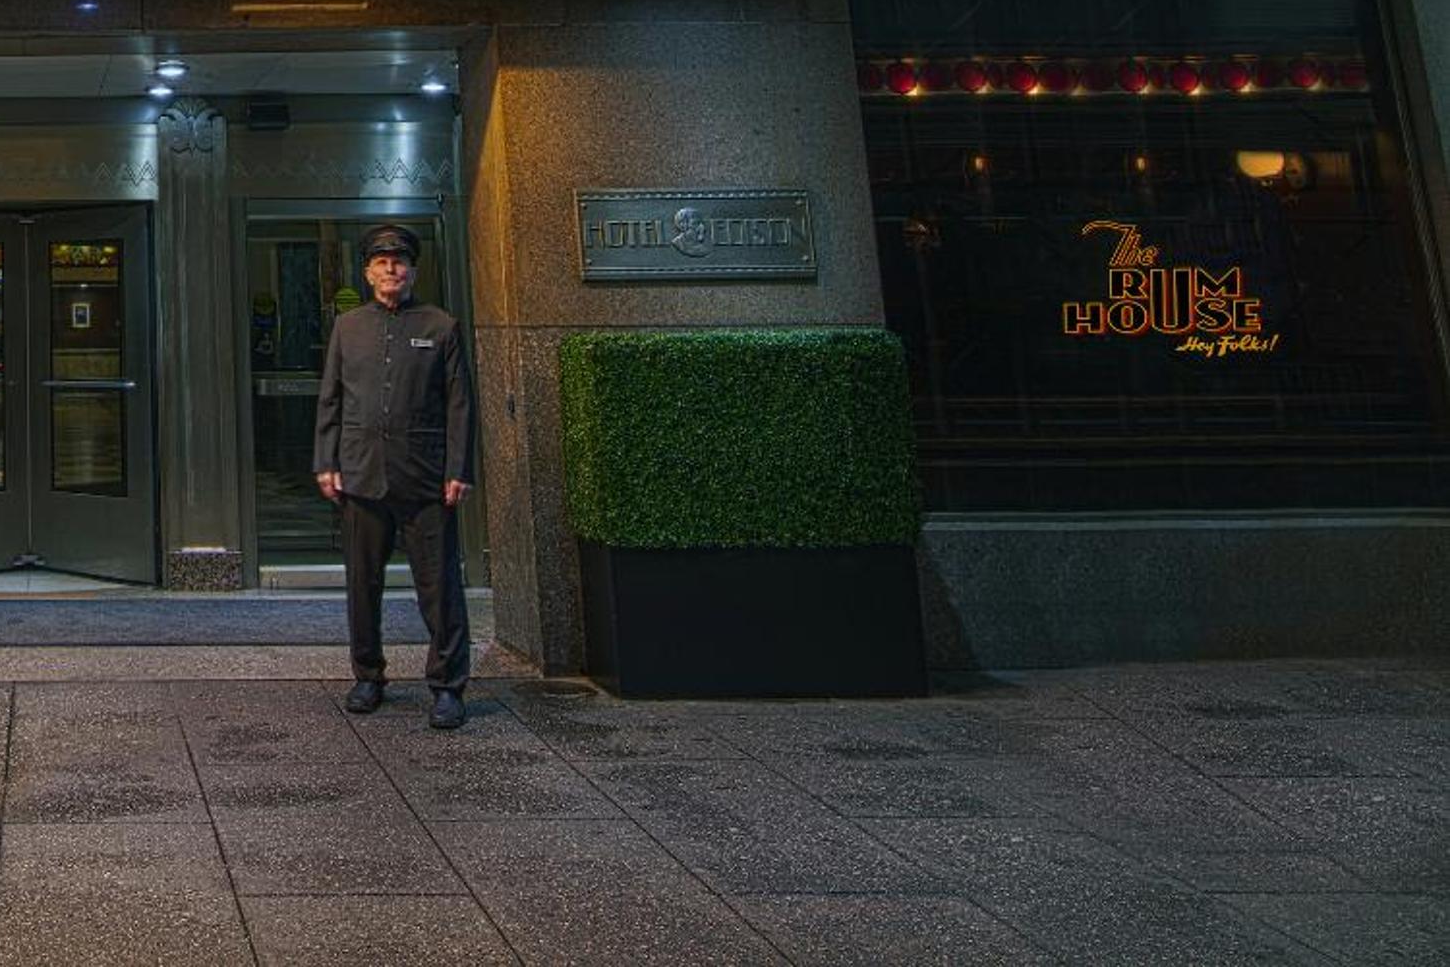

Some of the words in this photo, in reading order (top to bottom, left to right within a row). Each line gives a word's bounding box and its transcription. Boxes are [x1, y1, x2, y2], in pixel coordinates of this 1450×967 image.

[584, 218, 669, 249] HOTEL
[1080, 220, 1159, 267] The
[1109, 267, 1243, 334] RUM
[1175, 336, 1214, 358] Hey
[1217, 334, 1279, 357] Folks!
